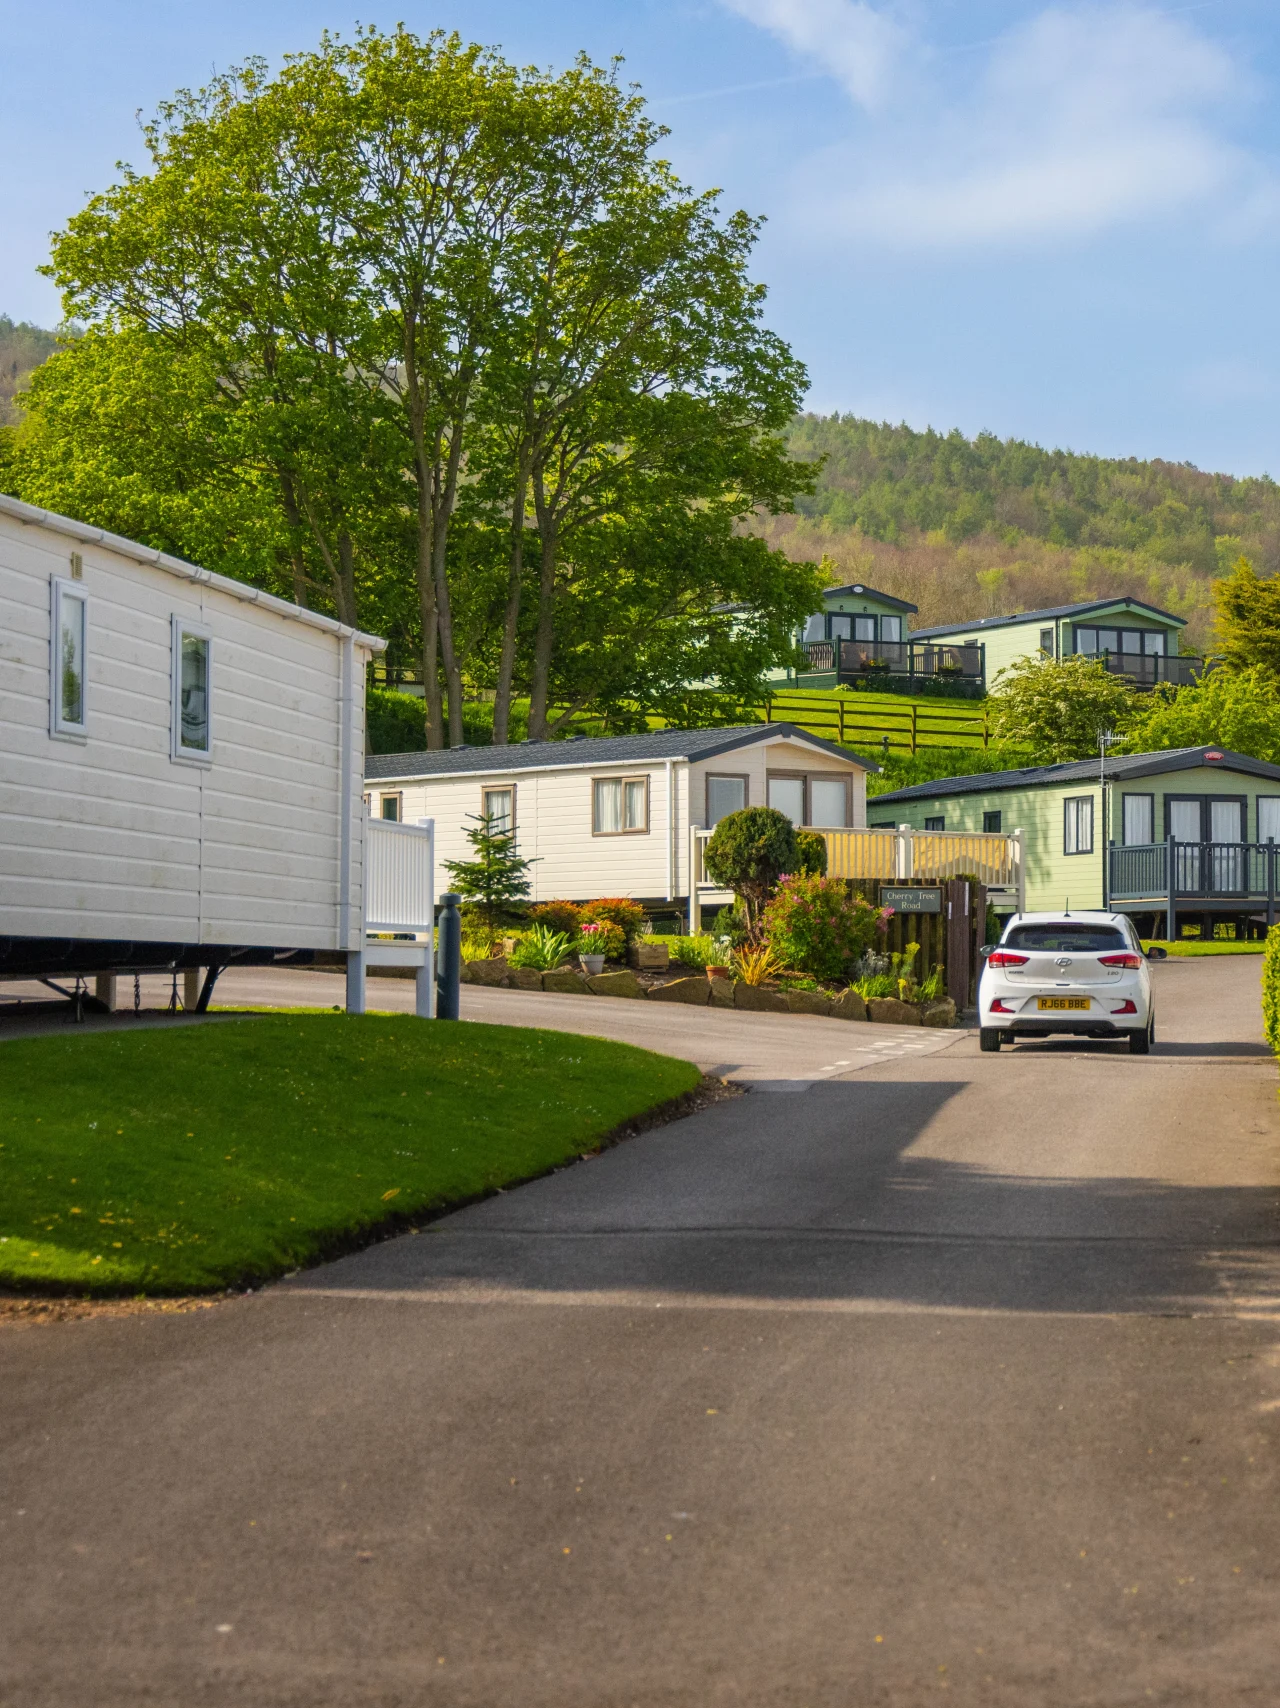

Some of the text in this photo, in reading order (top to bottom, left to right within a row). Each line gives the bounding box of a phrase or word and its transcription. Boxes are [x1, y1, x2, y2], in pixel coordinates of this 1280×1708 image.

[887, 891, 935, 901] Cherry Tree
[901, 901, 921, 909] Road
[1041, 999, 1086, 1009] RJ66 BBE
